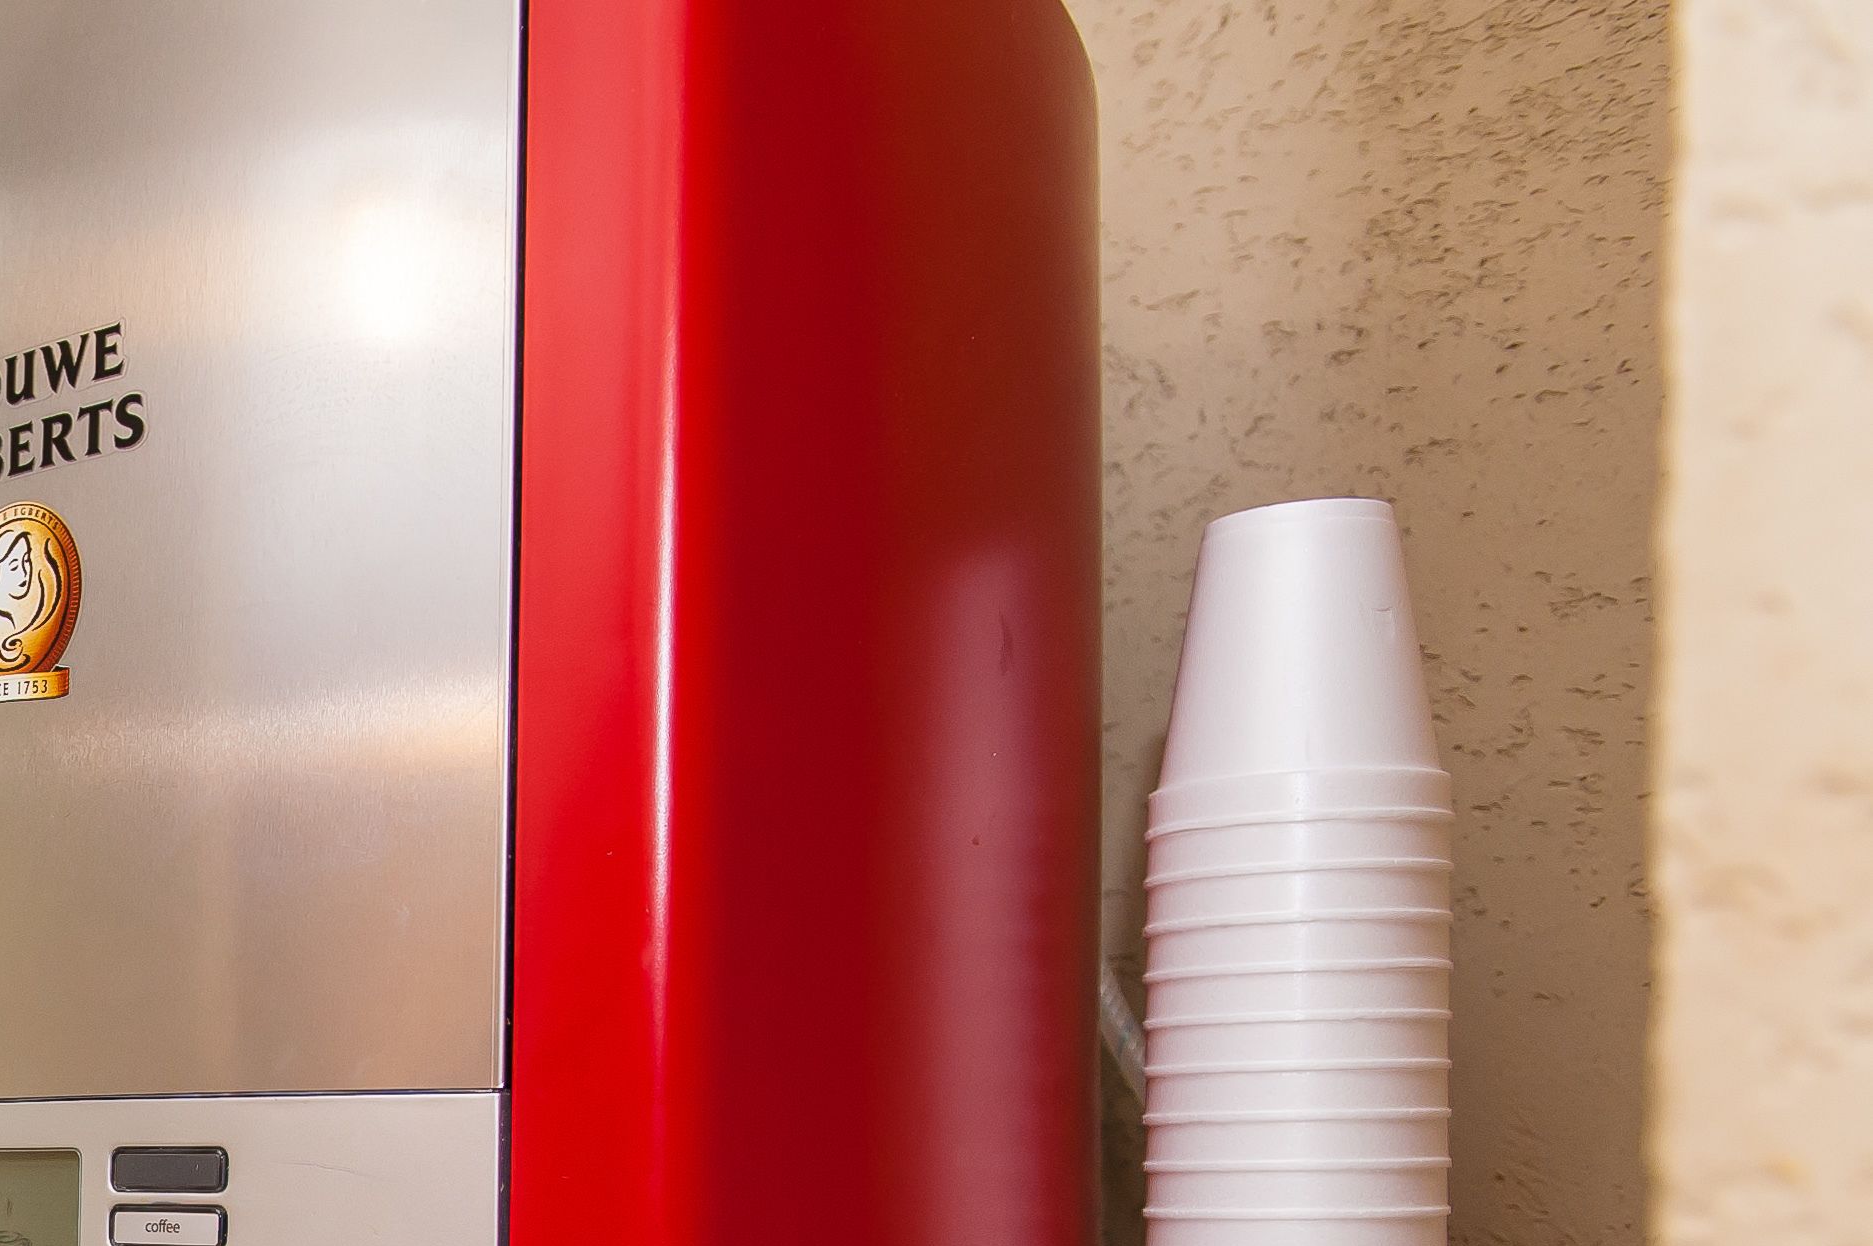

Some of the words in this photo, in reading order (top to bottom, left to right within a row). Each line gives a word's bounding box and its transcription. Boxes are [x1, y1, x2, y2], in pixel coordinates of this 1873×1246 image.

[13, 506, 61, 531] EGBERTS
[17, 679, 49, 695] 1753
[145, 1218, 181, 1234] coffee
